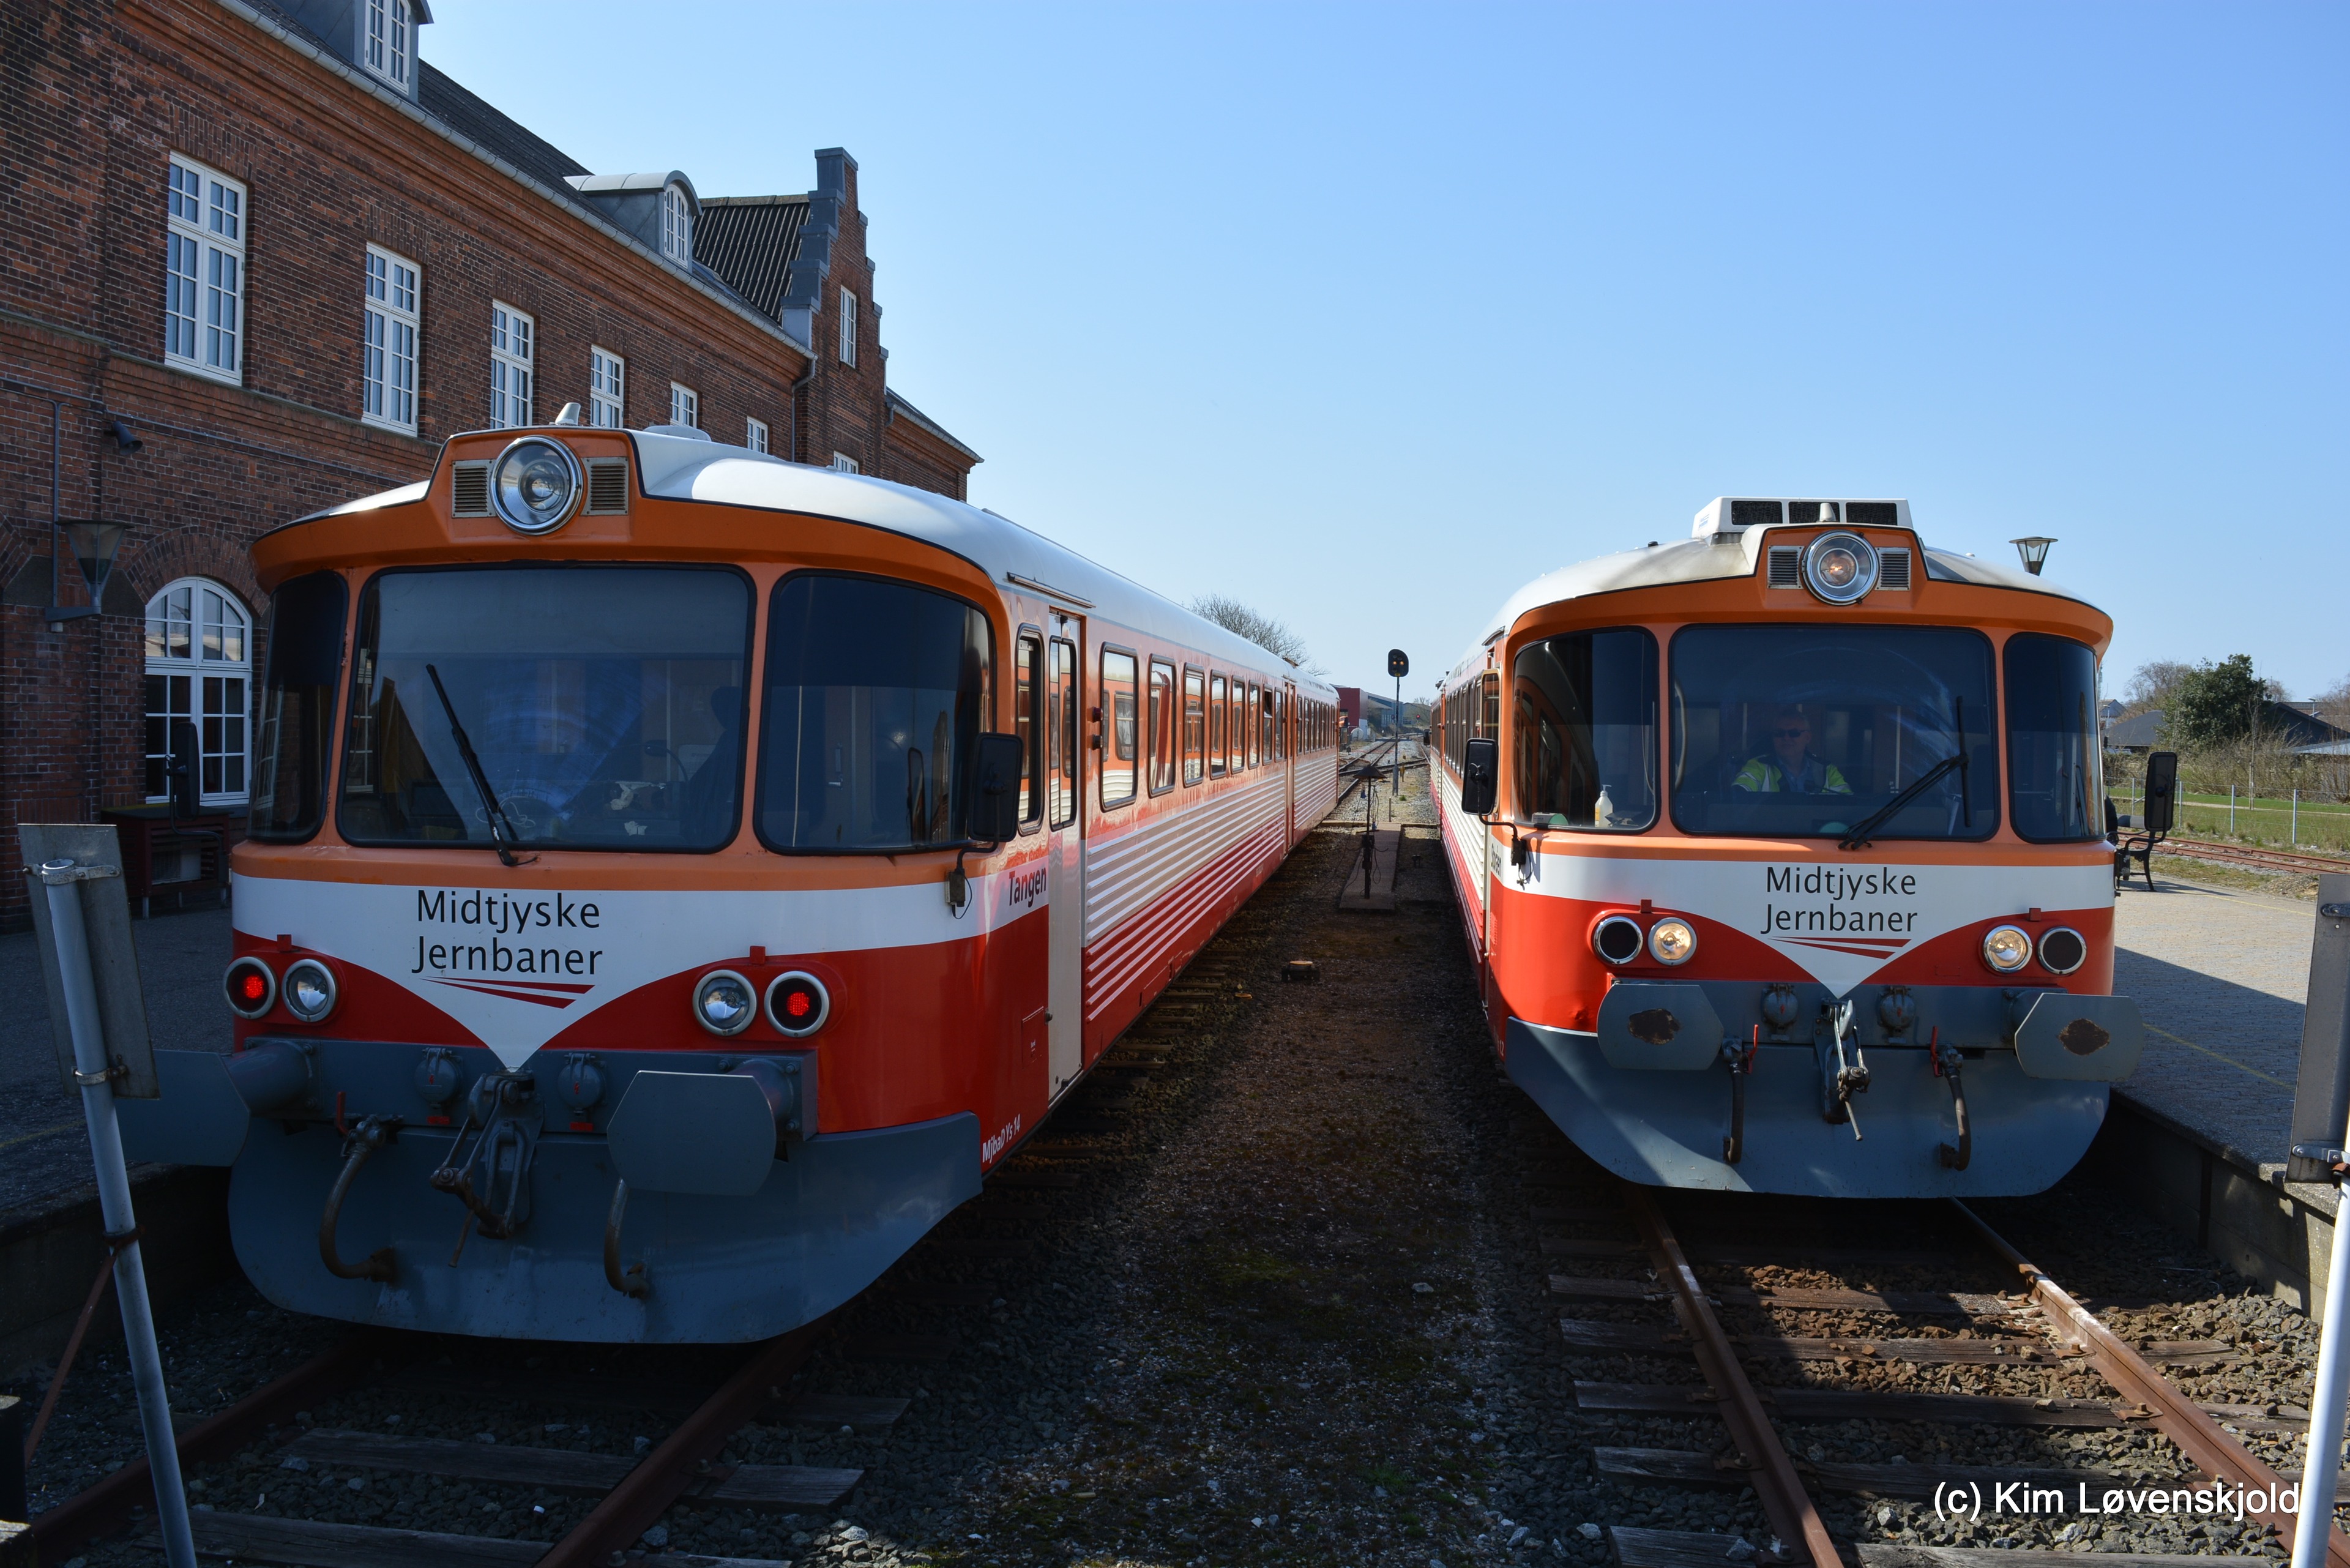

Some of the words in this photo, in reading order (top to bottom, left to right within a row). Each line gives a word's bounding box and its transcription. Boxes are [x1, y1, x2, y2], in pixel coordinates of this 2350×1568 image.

[1009, 867, 1046, 908] Tangen
[1766, 866, 1917, 900] Midtjyske
[417, 889, 600, 934] Midtjyske
[1760, 903, 1918, 935] Jernbaner
[411, 936, 603, 975] Jernbaner
[1005, 1122, 1013, 1143] Ys
[1014, 1113, 1020, 1135] 14
